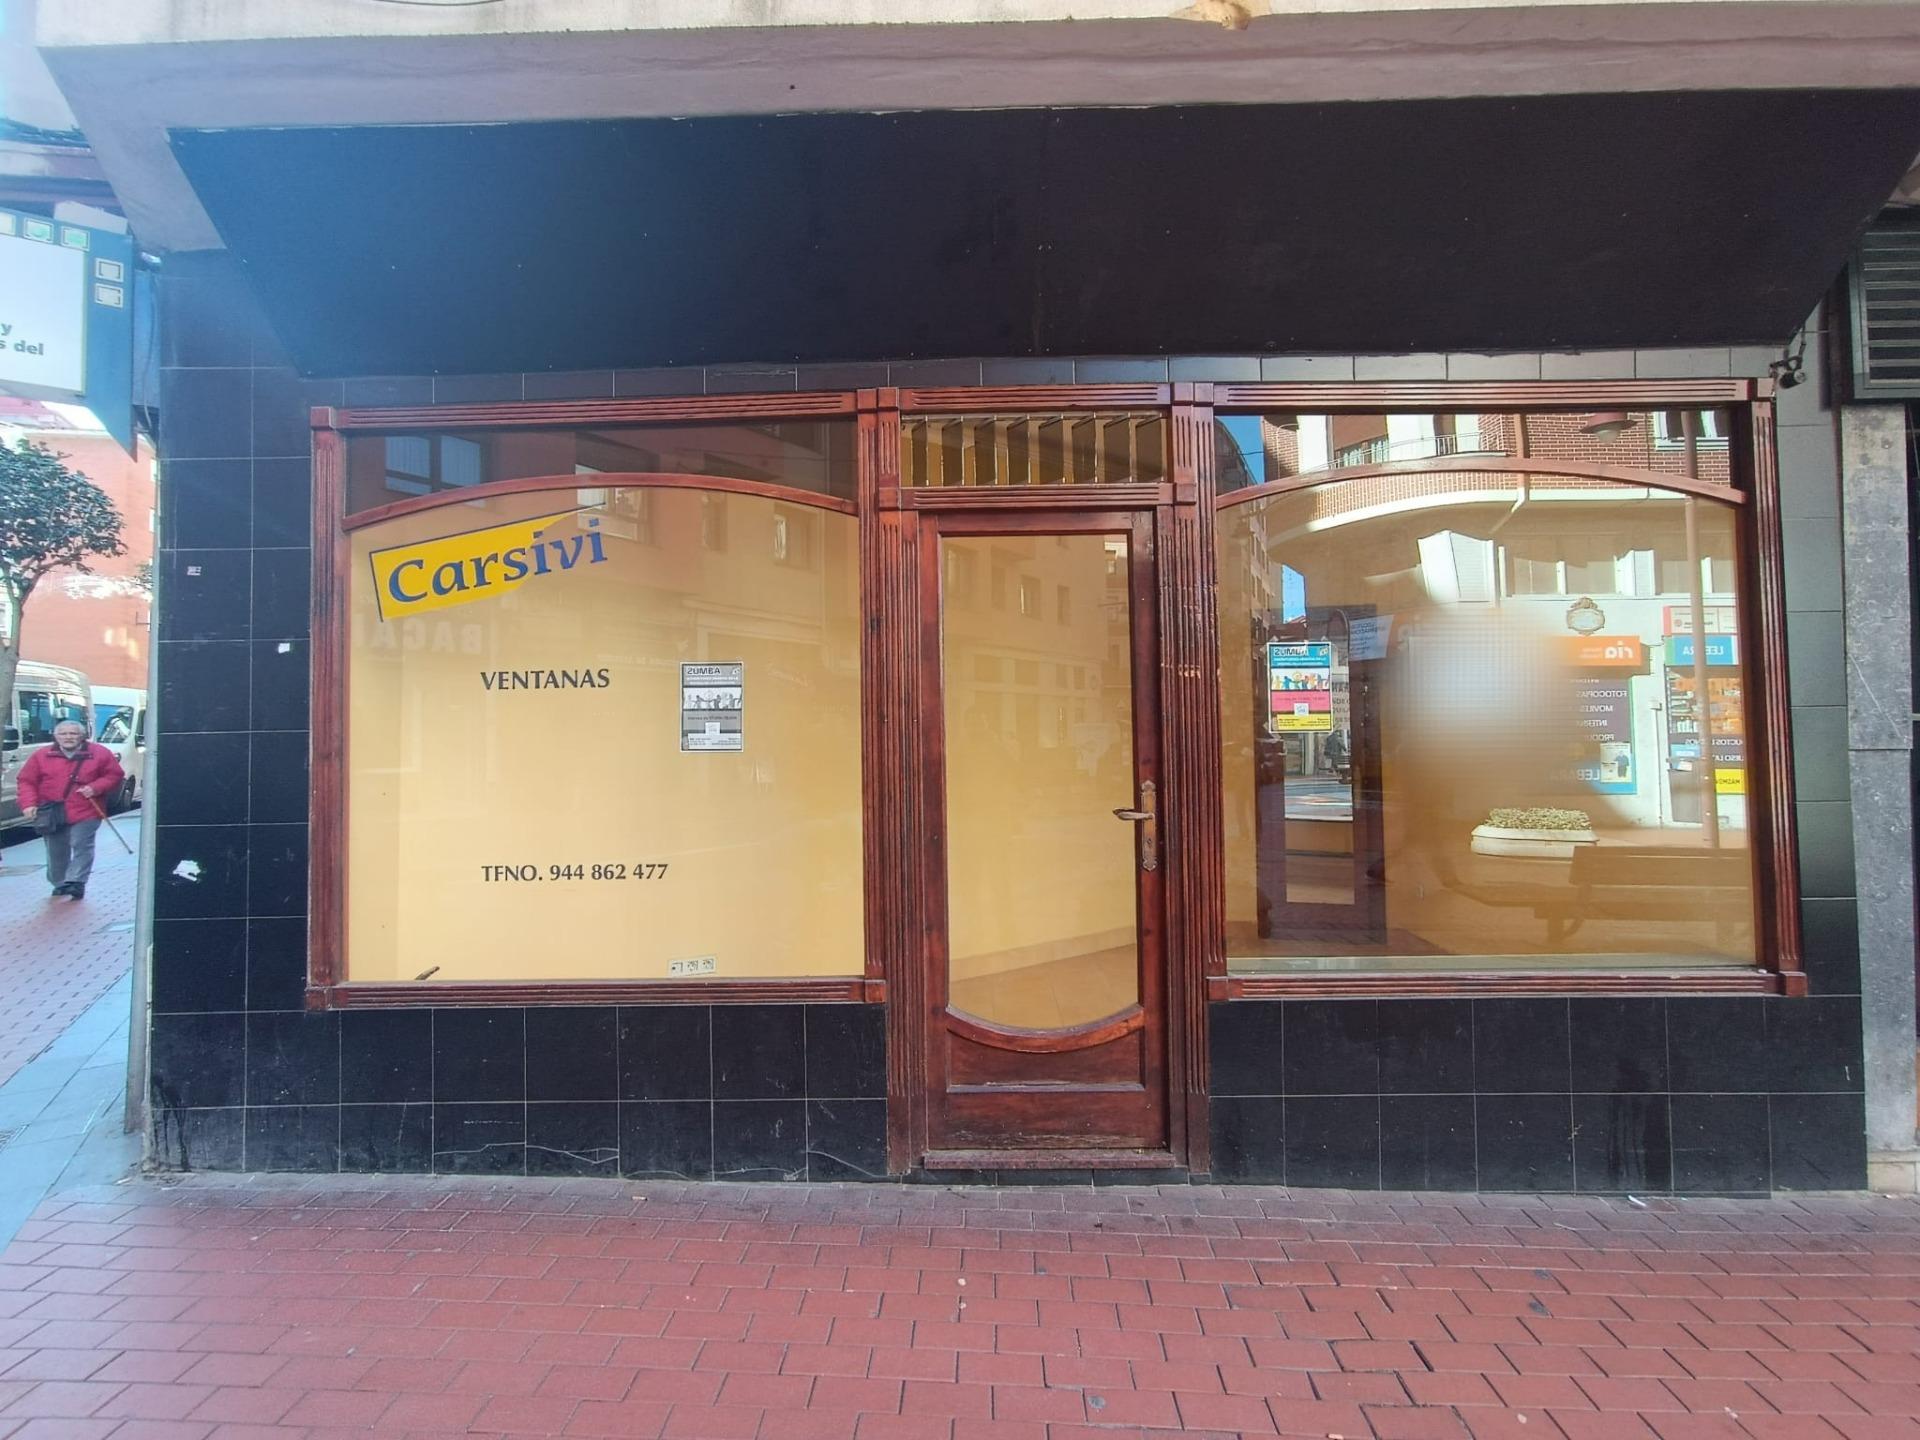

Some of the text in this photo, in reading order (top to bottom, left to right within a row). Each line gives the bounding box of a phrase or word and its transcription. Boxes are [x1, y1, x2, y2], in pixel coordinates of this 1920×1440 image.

[1, 323, 12, 336] y
[14, 340, 44, 355] del
[388, 518, 608, 603] Carsivi
[480, 668, 611, 691] VENTANAS
[481, 863, 669, 882] TFNO. 944 862 477
